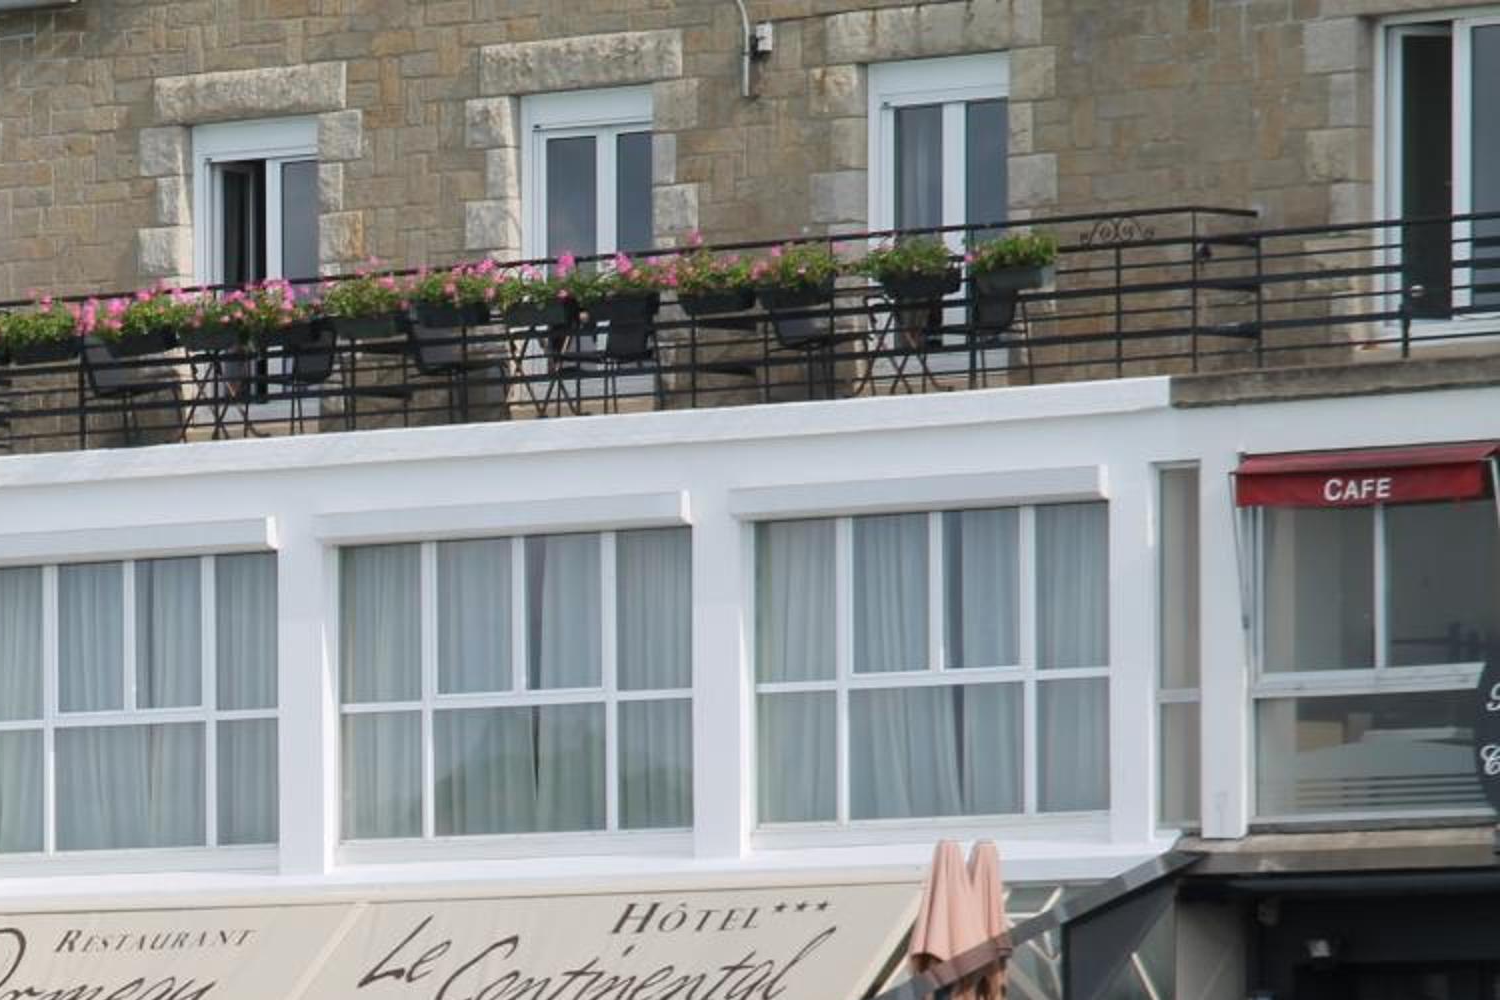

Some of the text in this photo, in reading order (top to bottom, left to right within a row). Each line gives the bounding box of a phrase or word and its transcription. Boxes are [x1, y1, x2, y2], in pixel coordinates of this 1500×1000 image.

[1323, 478, 1391, 501] CAFE
[54, 928, 258, 953] RESTAURANT
[357, 914, 452, 989] Le
